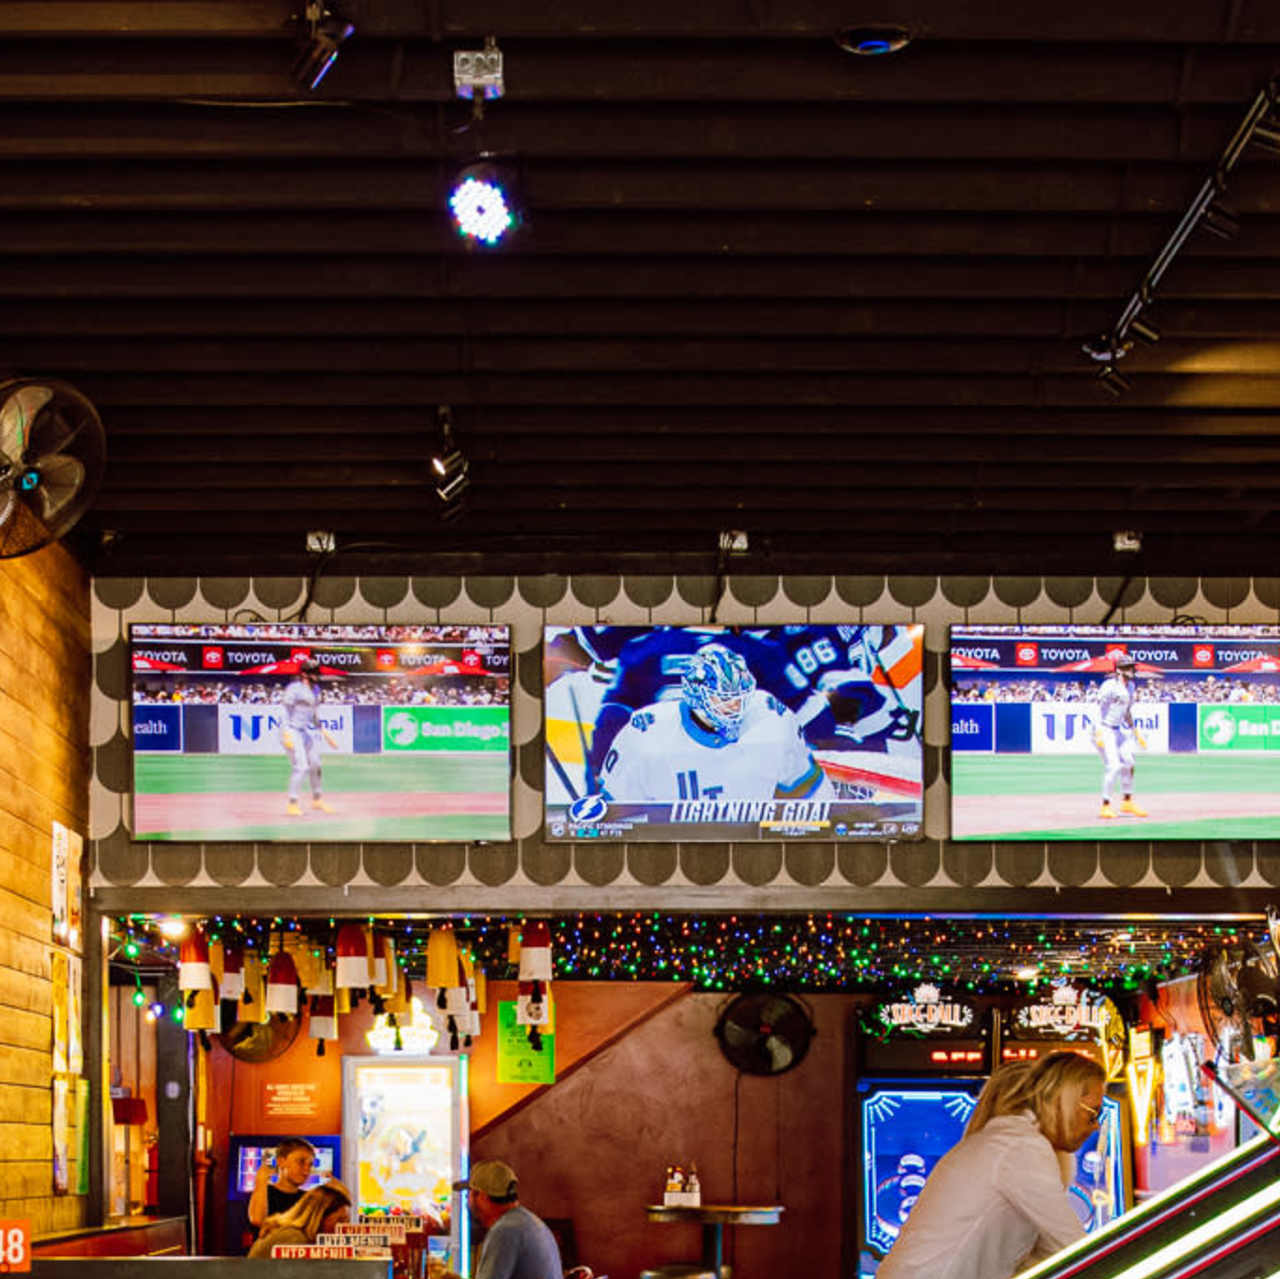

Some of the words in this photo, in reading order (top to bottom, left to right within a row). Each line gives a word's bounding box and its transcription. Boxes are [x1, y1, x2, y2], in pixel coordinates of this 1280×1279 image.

[227, 652, 277, 664] TOYOTA
[314, 653, 362, 665] TOYOTA
[1040, 649, 1091, 662] TOYOTA
[1130, 650, 1179, 662] TOYOTA
[1216, 651, 1267, 662] TOYOTA
[670, 800, 776, 822] LIGHTNING
[782, 801, 832, 822] GOAL
